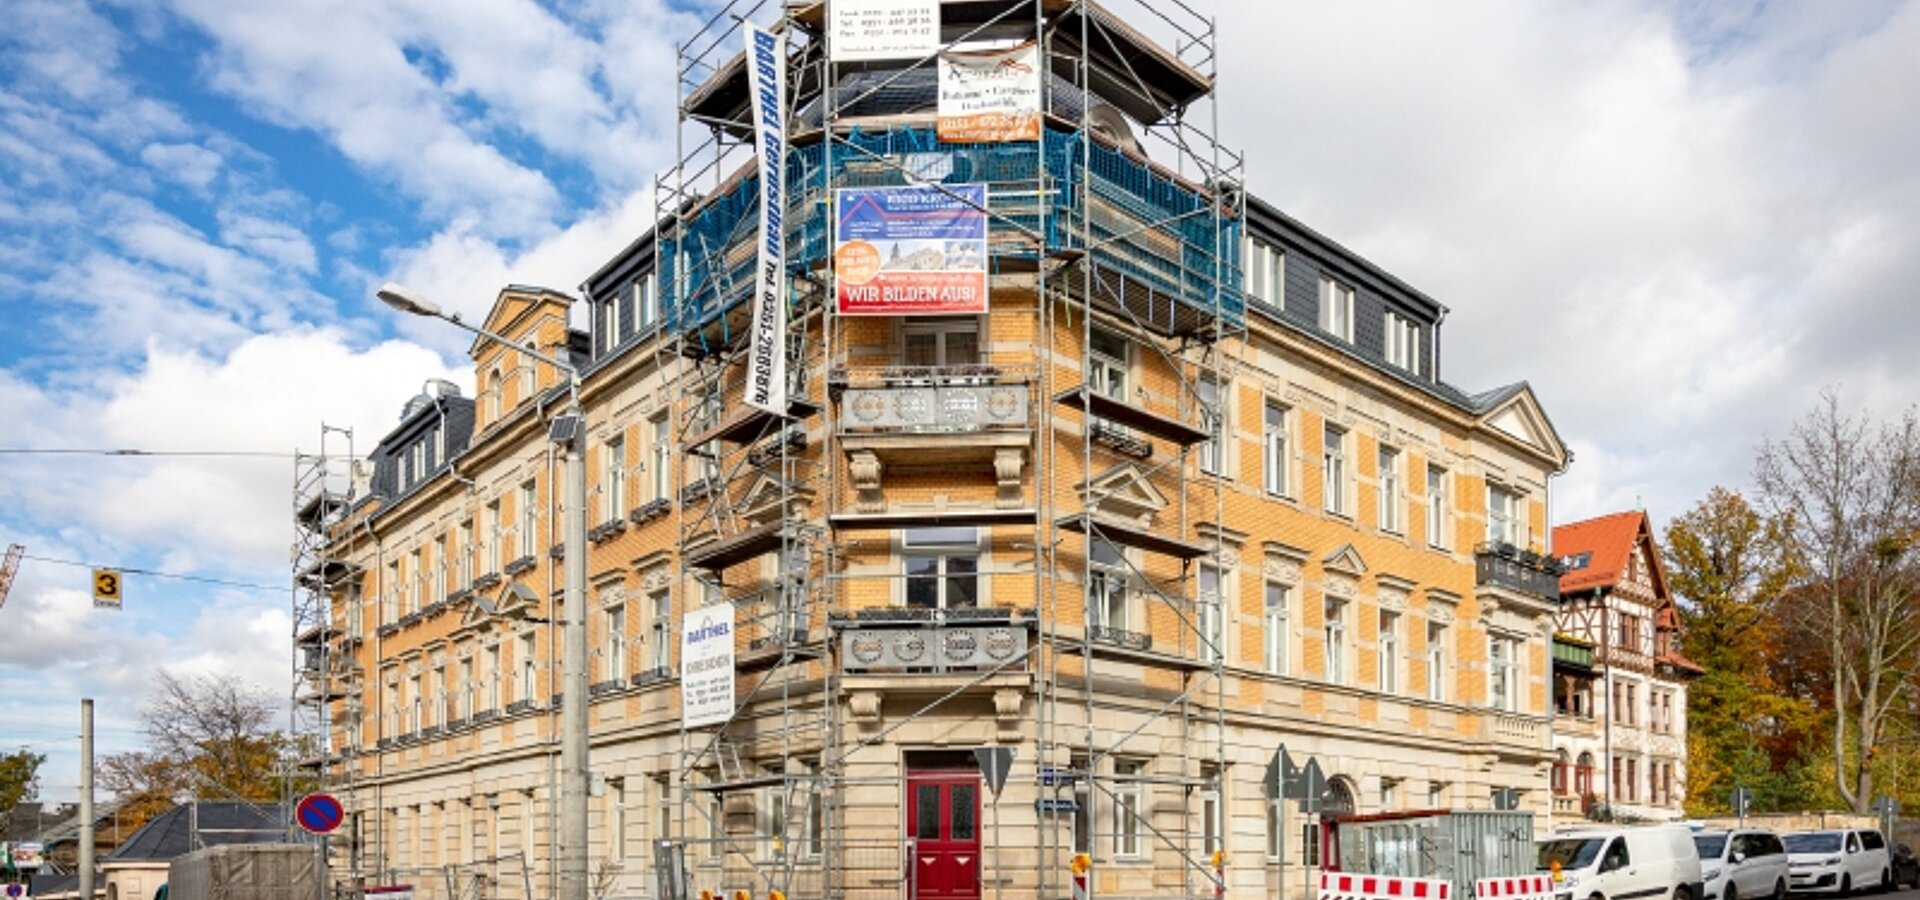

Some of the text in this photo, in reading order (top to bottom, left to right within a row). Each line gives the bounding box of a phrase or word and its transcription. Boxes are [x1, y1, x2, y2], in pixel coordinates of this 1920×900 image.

[754, 29, 780, 130] BARTHEL
[846, 285, 976, 303] WIR BILDEN AUS!
[97, 573, 117, 596] 3
